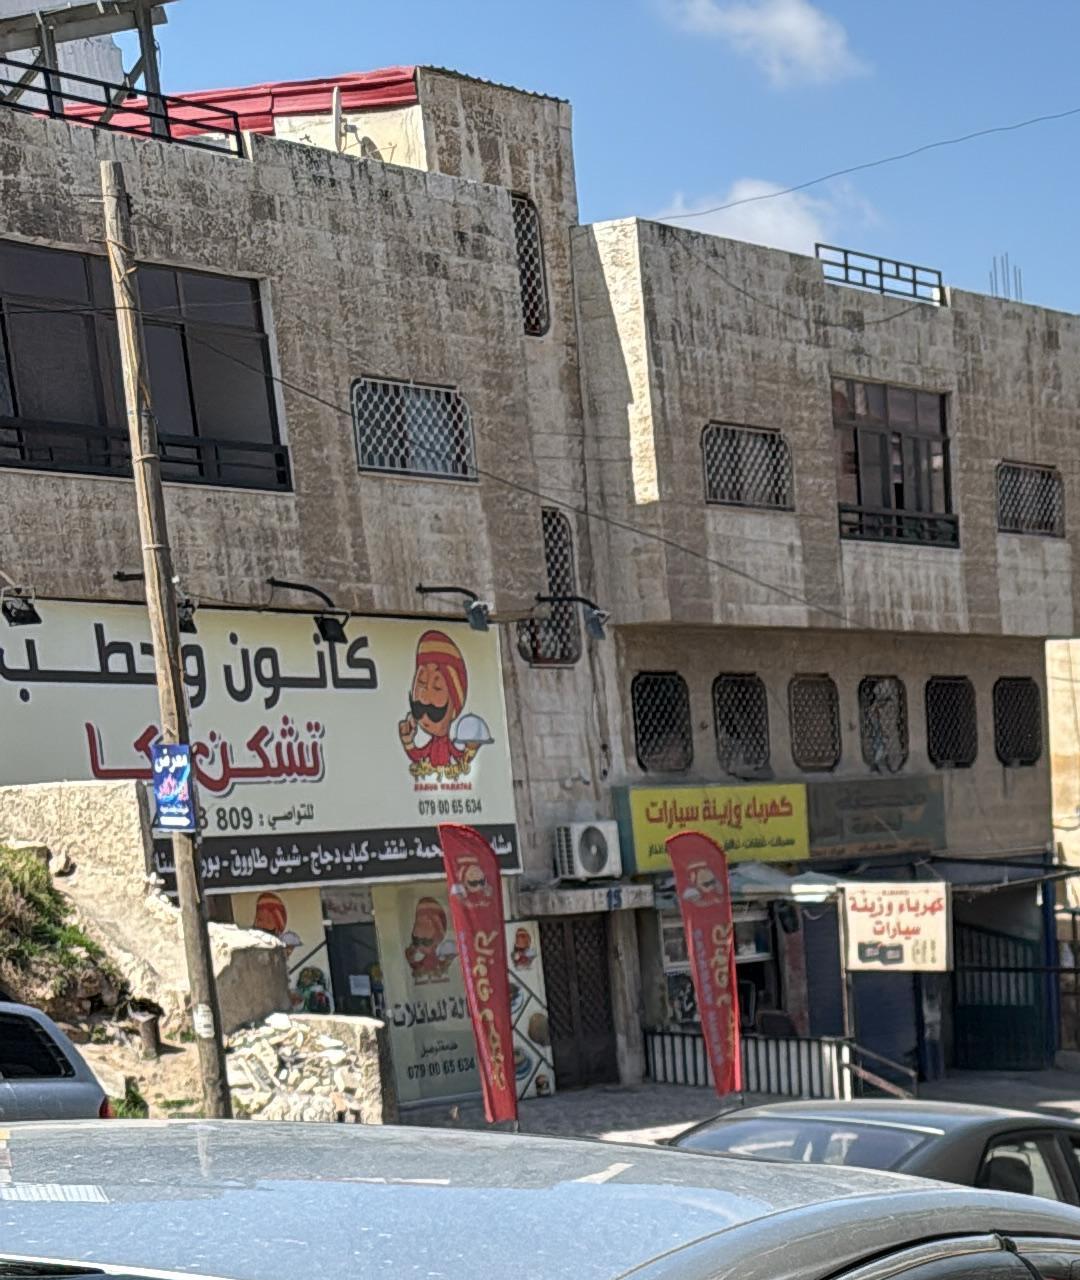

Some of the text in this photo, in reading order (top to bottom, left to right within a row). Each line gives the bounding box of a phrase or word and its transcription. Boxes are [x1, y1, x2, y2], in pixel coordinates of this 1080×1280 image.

[223, 631, 378, 710] كانون
[84, 721, 160, 781] كا
[216, 806, 254, 831] 809
[645, 799, 699, 829] سيارات
[898, 896, 945, 917] كهرباء
[872, 919, 921, 941] سيارات
[448, 995, 472, 1020] الة
